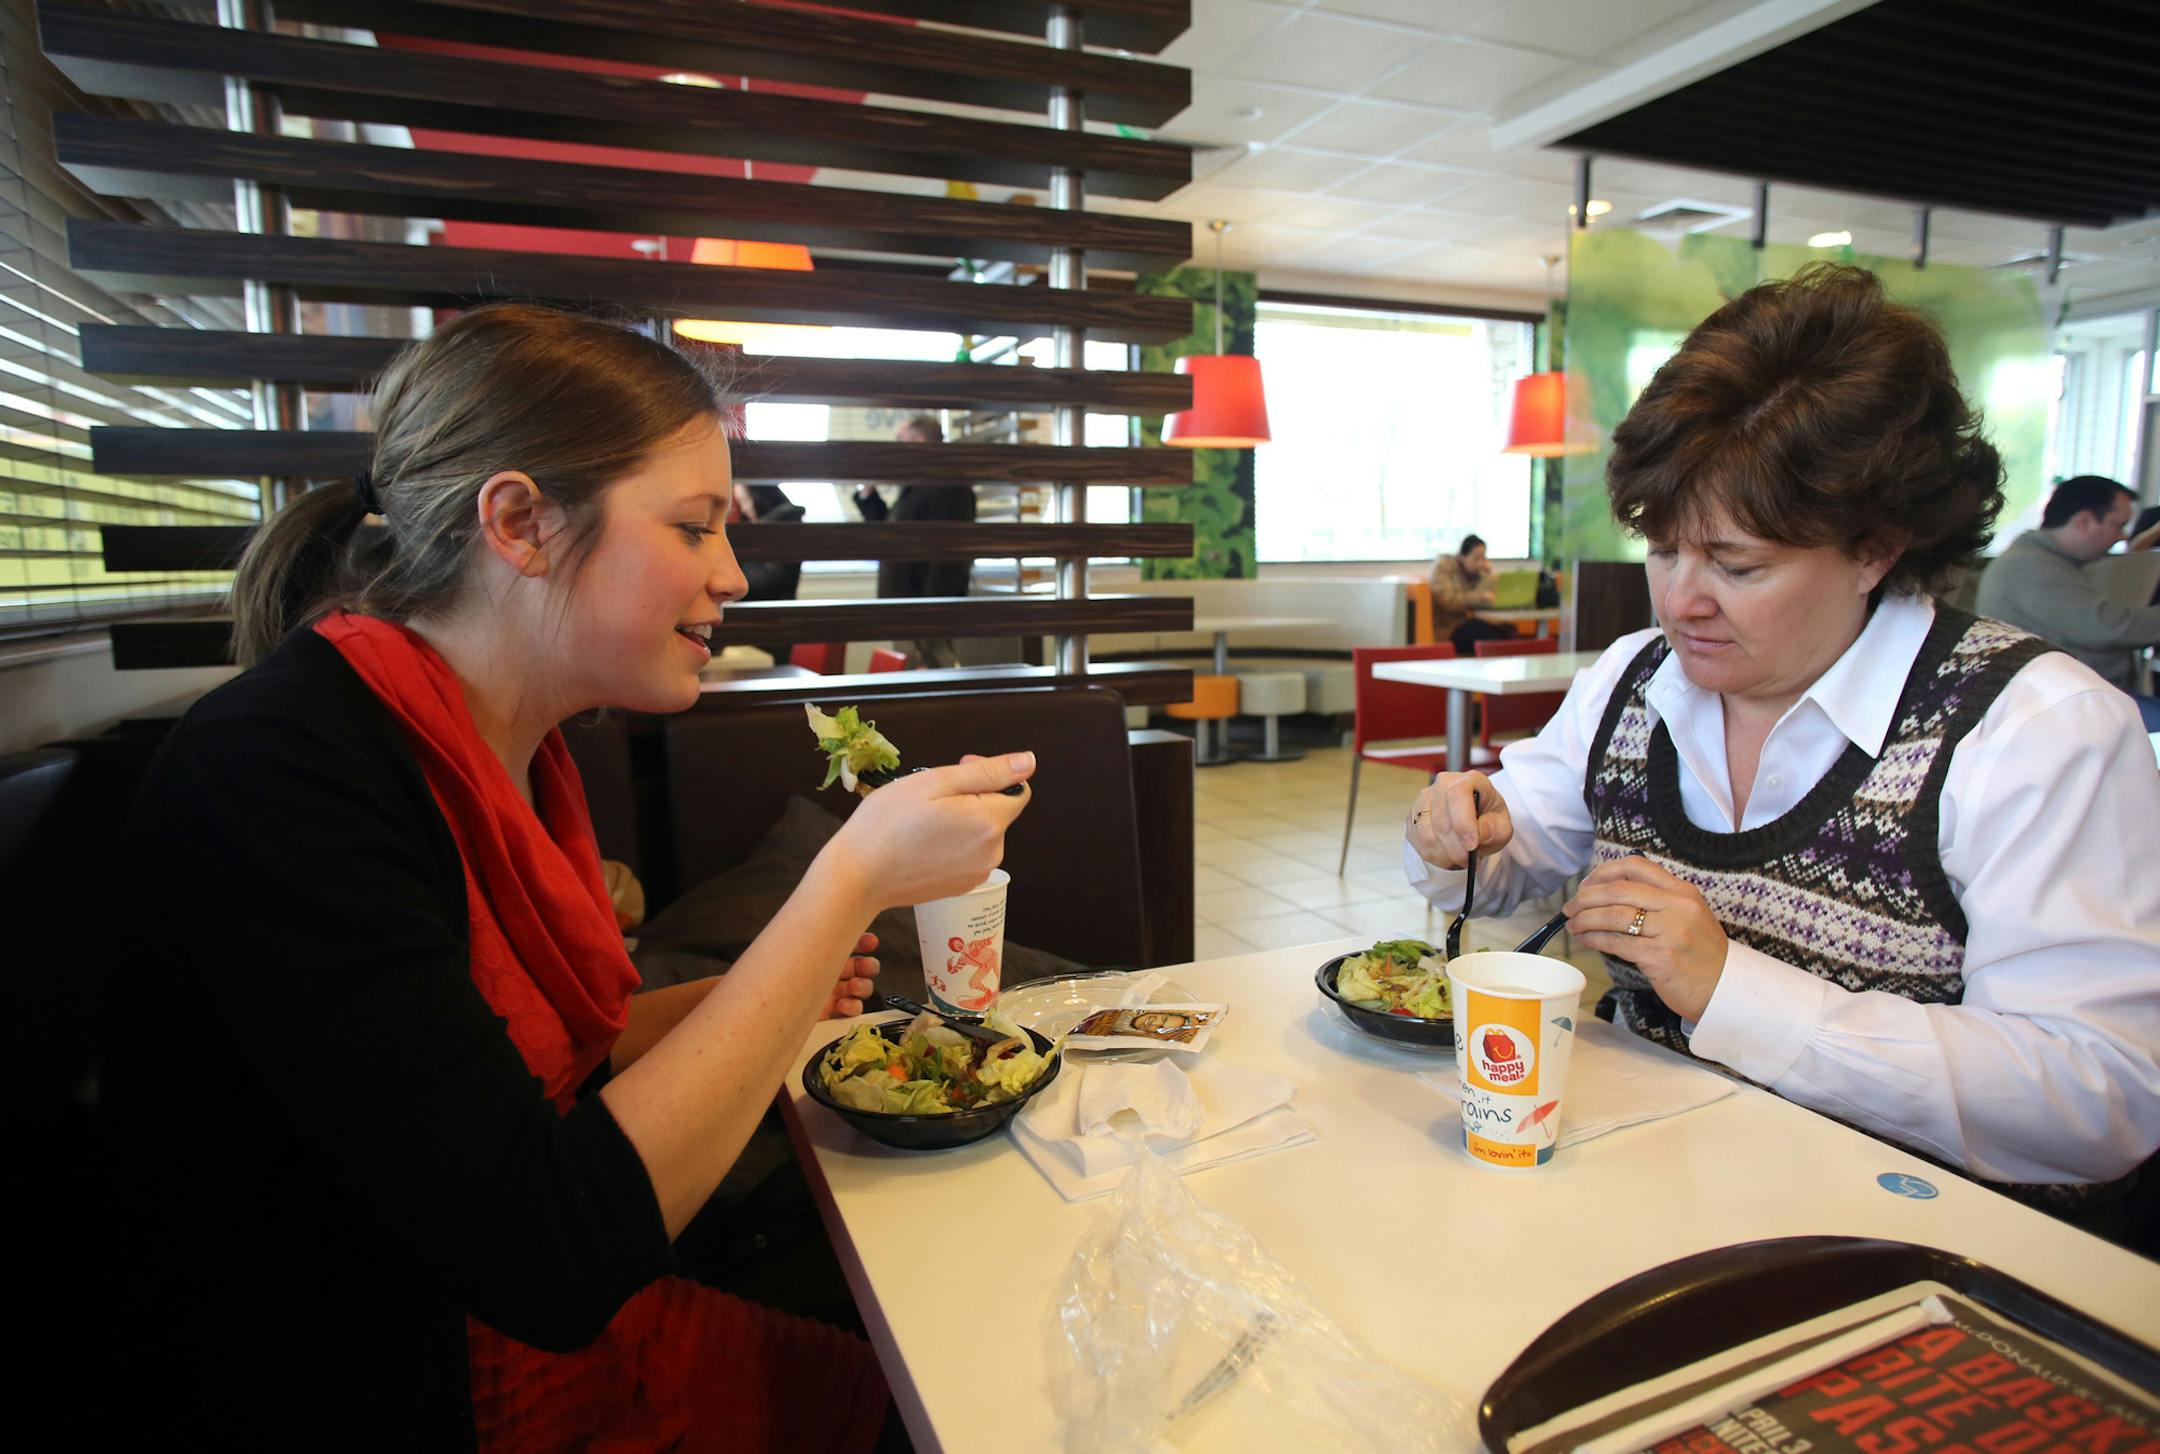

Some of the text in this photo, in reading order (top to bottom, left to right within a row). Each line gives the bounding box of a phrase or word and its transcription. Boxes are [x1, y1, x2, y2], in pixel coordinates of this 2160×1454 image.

[1482, 1059, 1525, 1074] happy
[1489, 1071, 1520, 1082] meal
[1461, 1099, 1512, 1123] rains
[1901, 1327, 2160, 1454] A BASK
[1735, 1404, 1793, 1448] PRIL
[1776, 1369, 1980, 1454] PAS
